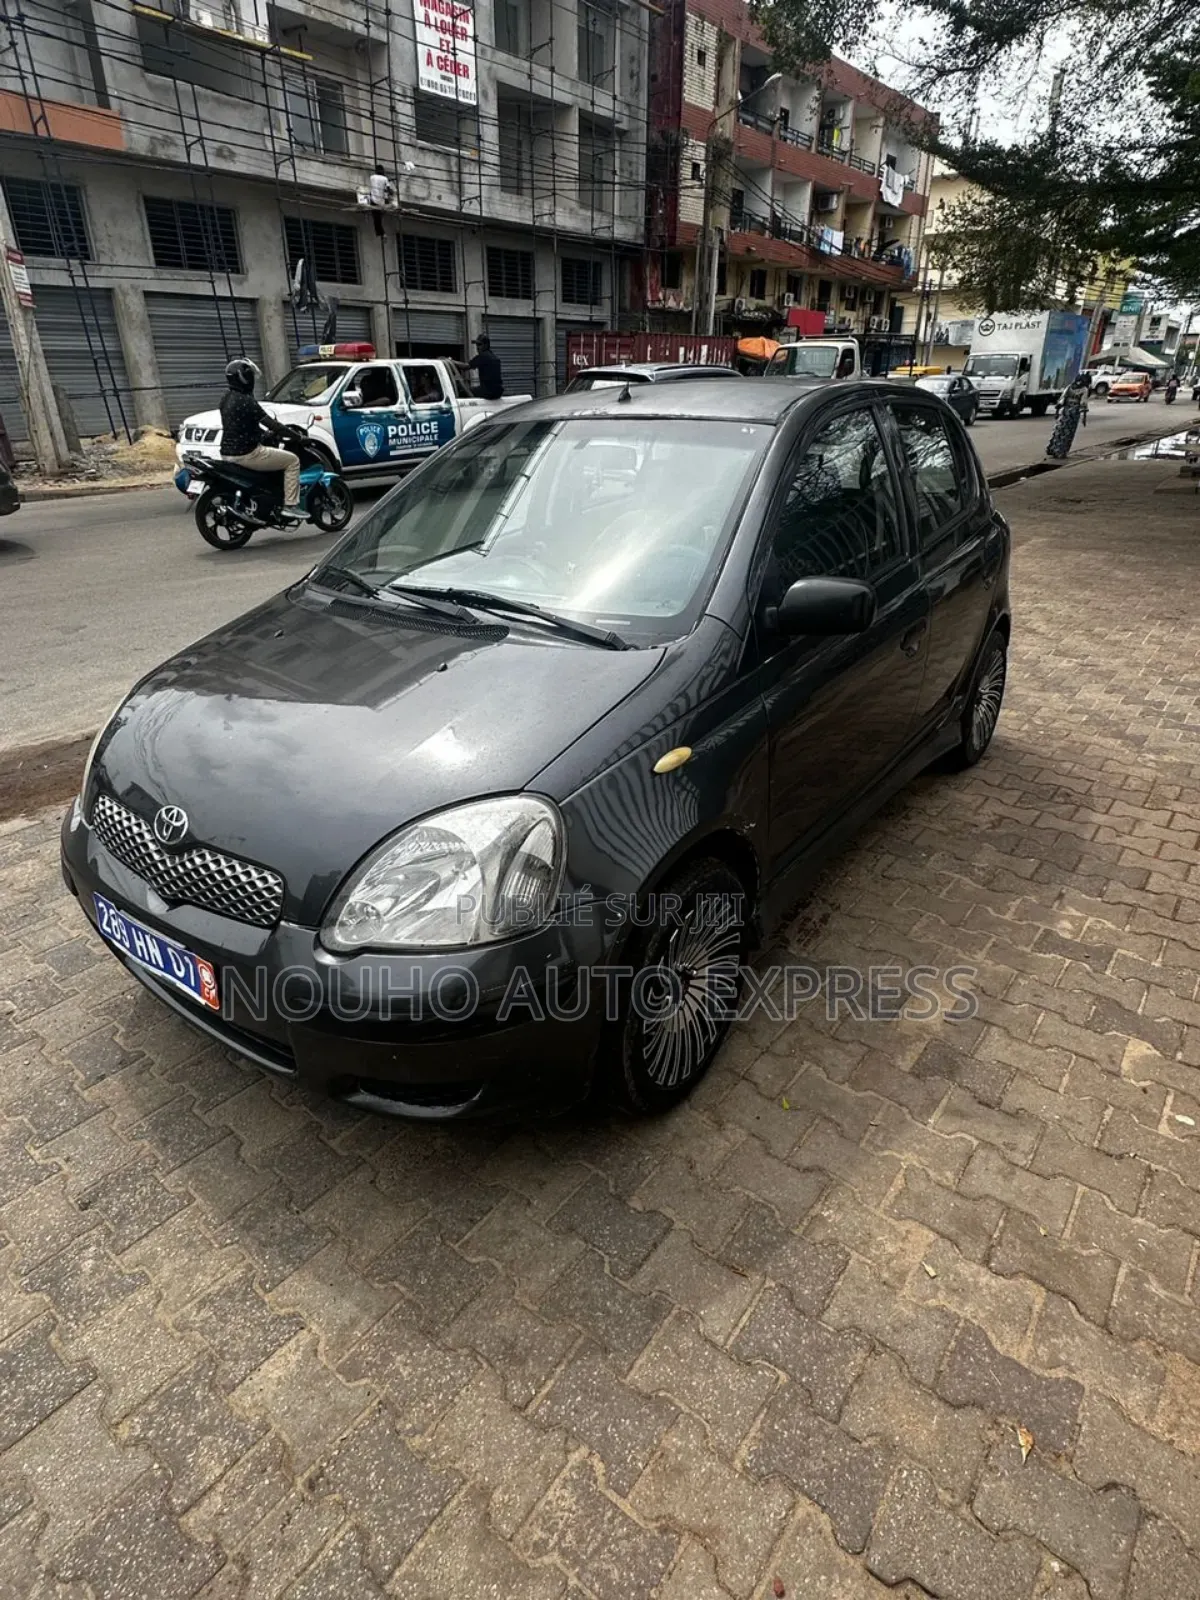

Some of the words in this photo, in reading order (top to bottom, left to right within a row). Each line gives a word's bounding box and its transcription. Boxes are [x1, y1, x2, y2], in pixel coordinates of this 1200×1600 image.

[434, 16, 468, 42] LOUER
[440, 38, 451, 54] ET
[426, 48, 434, 68] À
[436, 55, 470, 79] CÉDER
[996, 323, 1013, 331] TAJ
[1014, 321, 1042, 330] PLAST
[387, 421, 439, 438] POLICE
[388, 433, 439, 446] MUNICIPALE
[131, 927, 164, 969] HN
